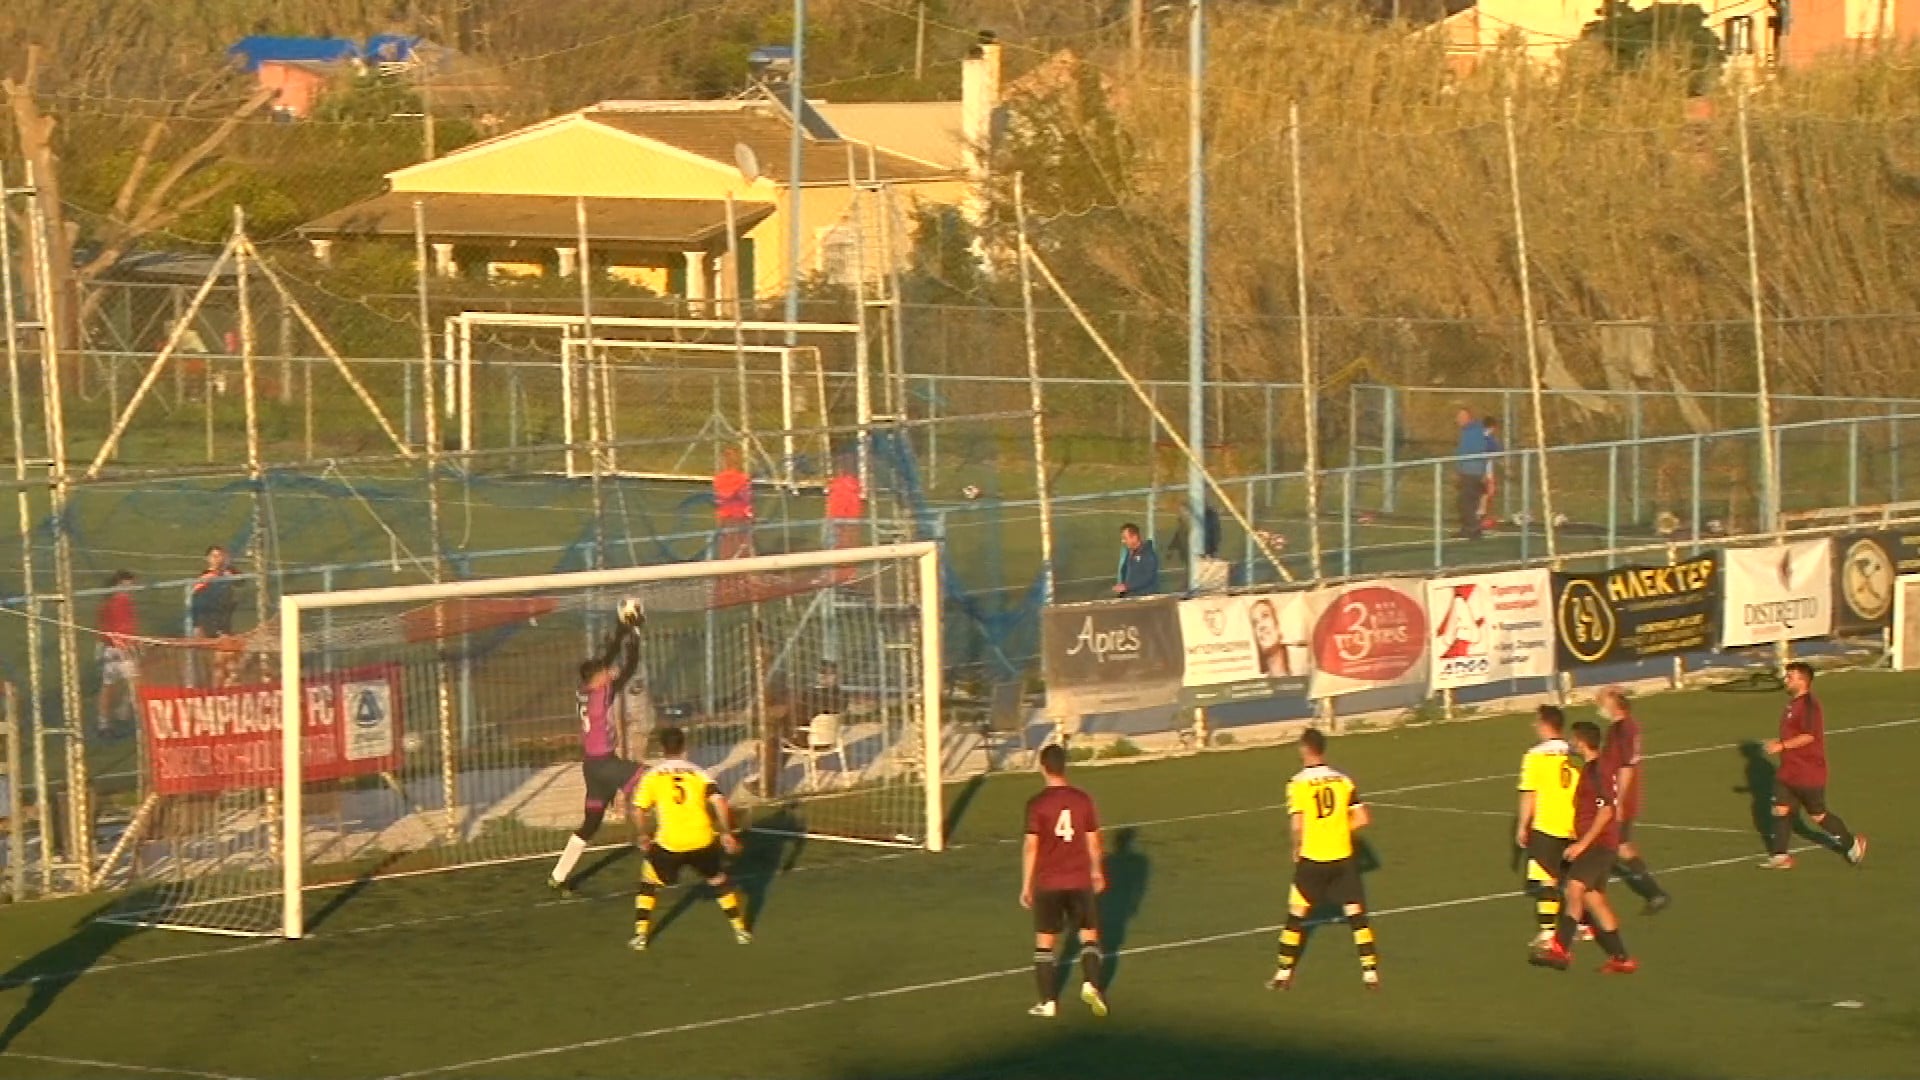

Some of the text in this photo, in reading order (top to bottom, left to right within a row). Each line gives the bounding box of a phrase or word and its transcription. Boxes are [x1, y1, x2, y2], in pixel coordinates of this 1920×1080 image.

[147, 684, 335, 739] OLYMPIACO FC
[671, 776, 687, 806] 5
[1312, 786, 1335, 819] 19
[1054, 809, 1075, 843] 4
